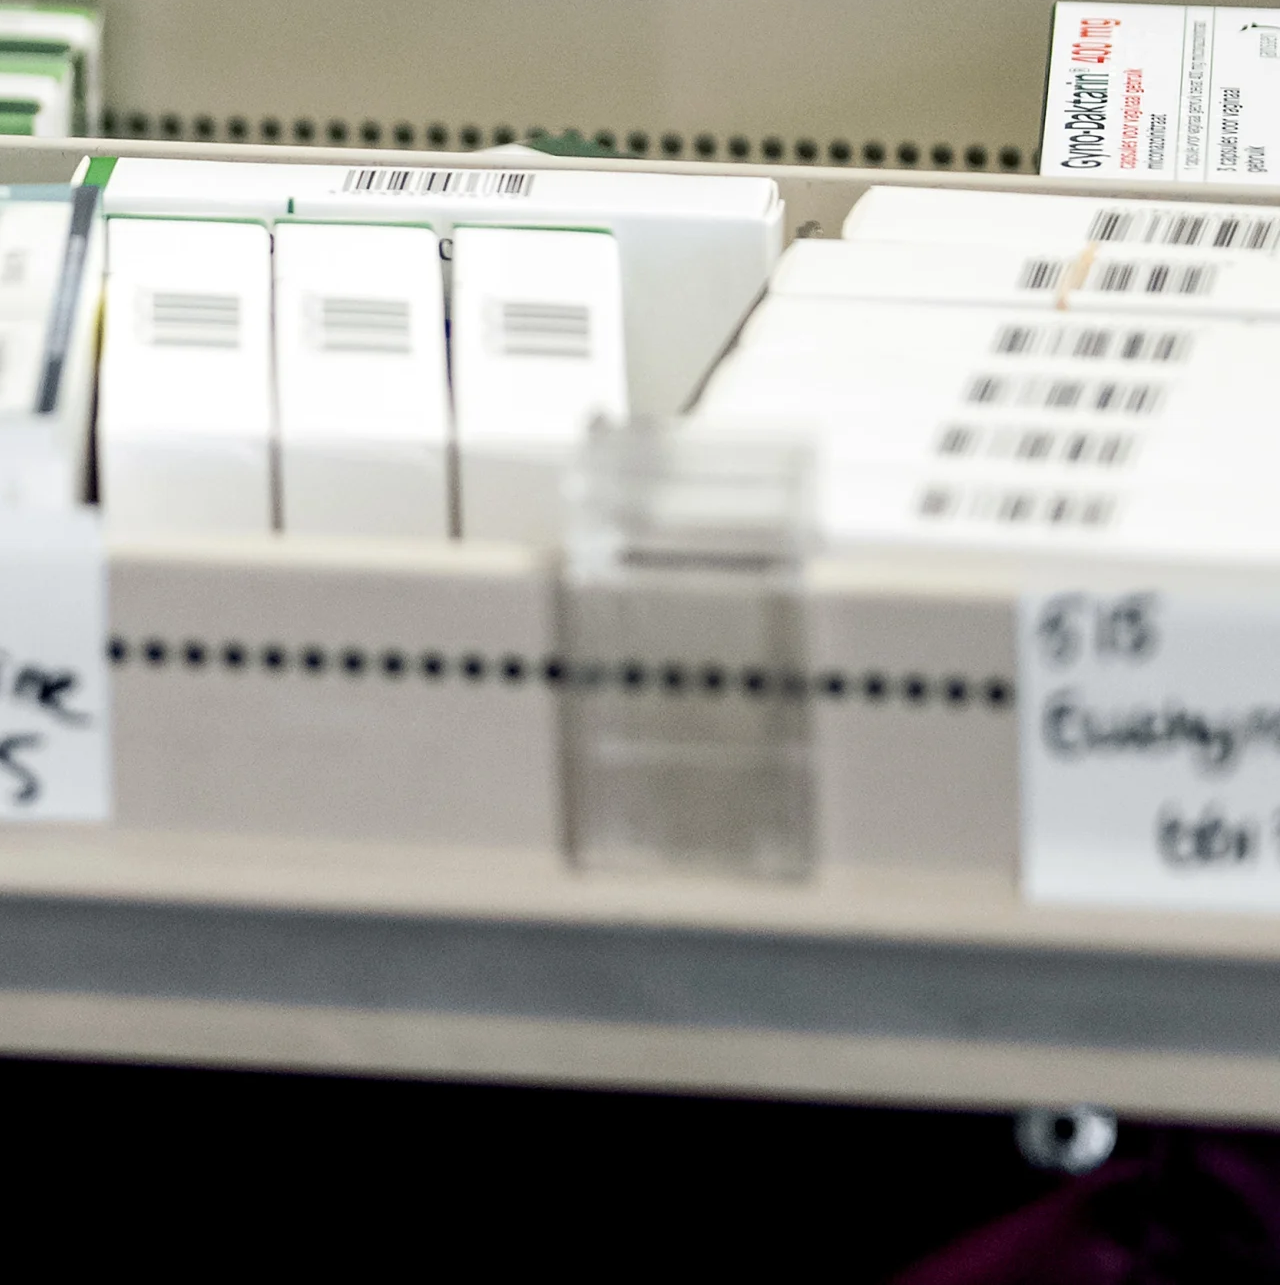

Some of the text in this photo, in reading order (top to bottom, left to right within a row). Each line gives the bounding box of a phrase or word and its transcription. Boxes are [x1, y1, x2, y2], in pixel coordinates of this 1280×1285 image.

[1061, 18, 1122, 169] Gyno-Daktarin 400 mg
